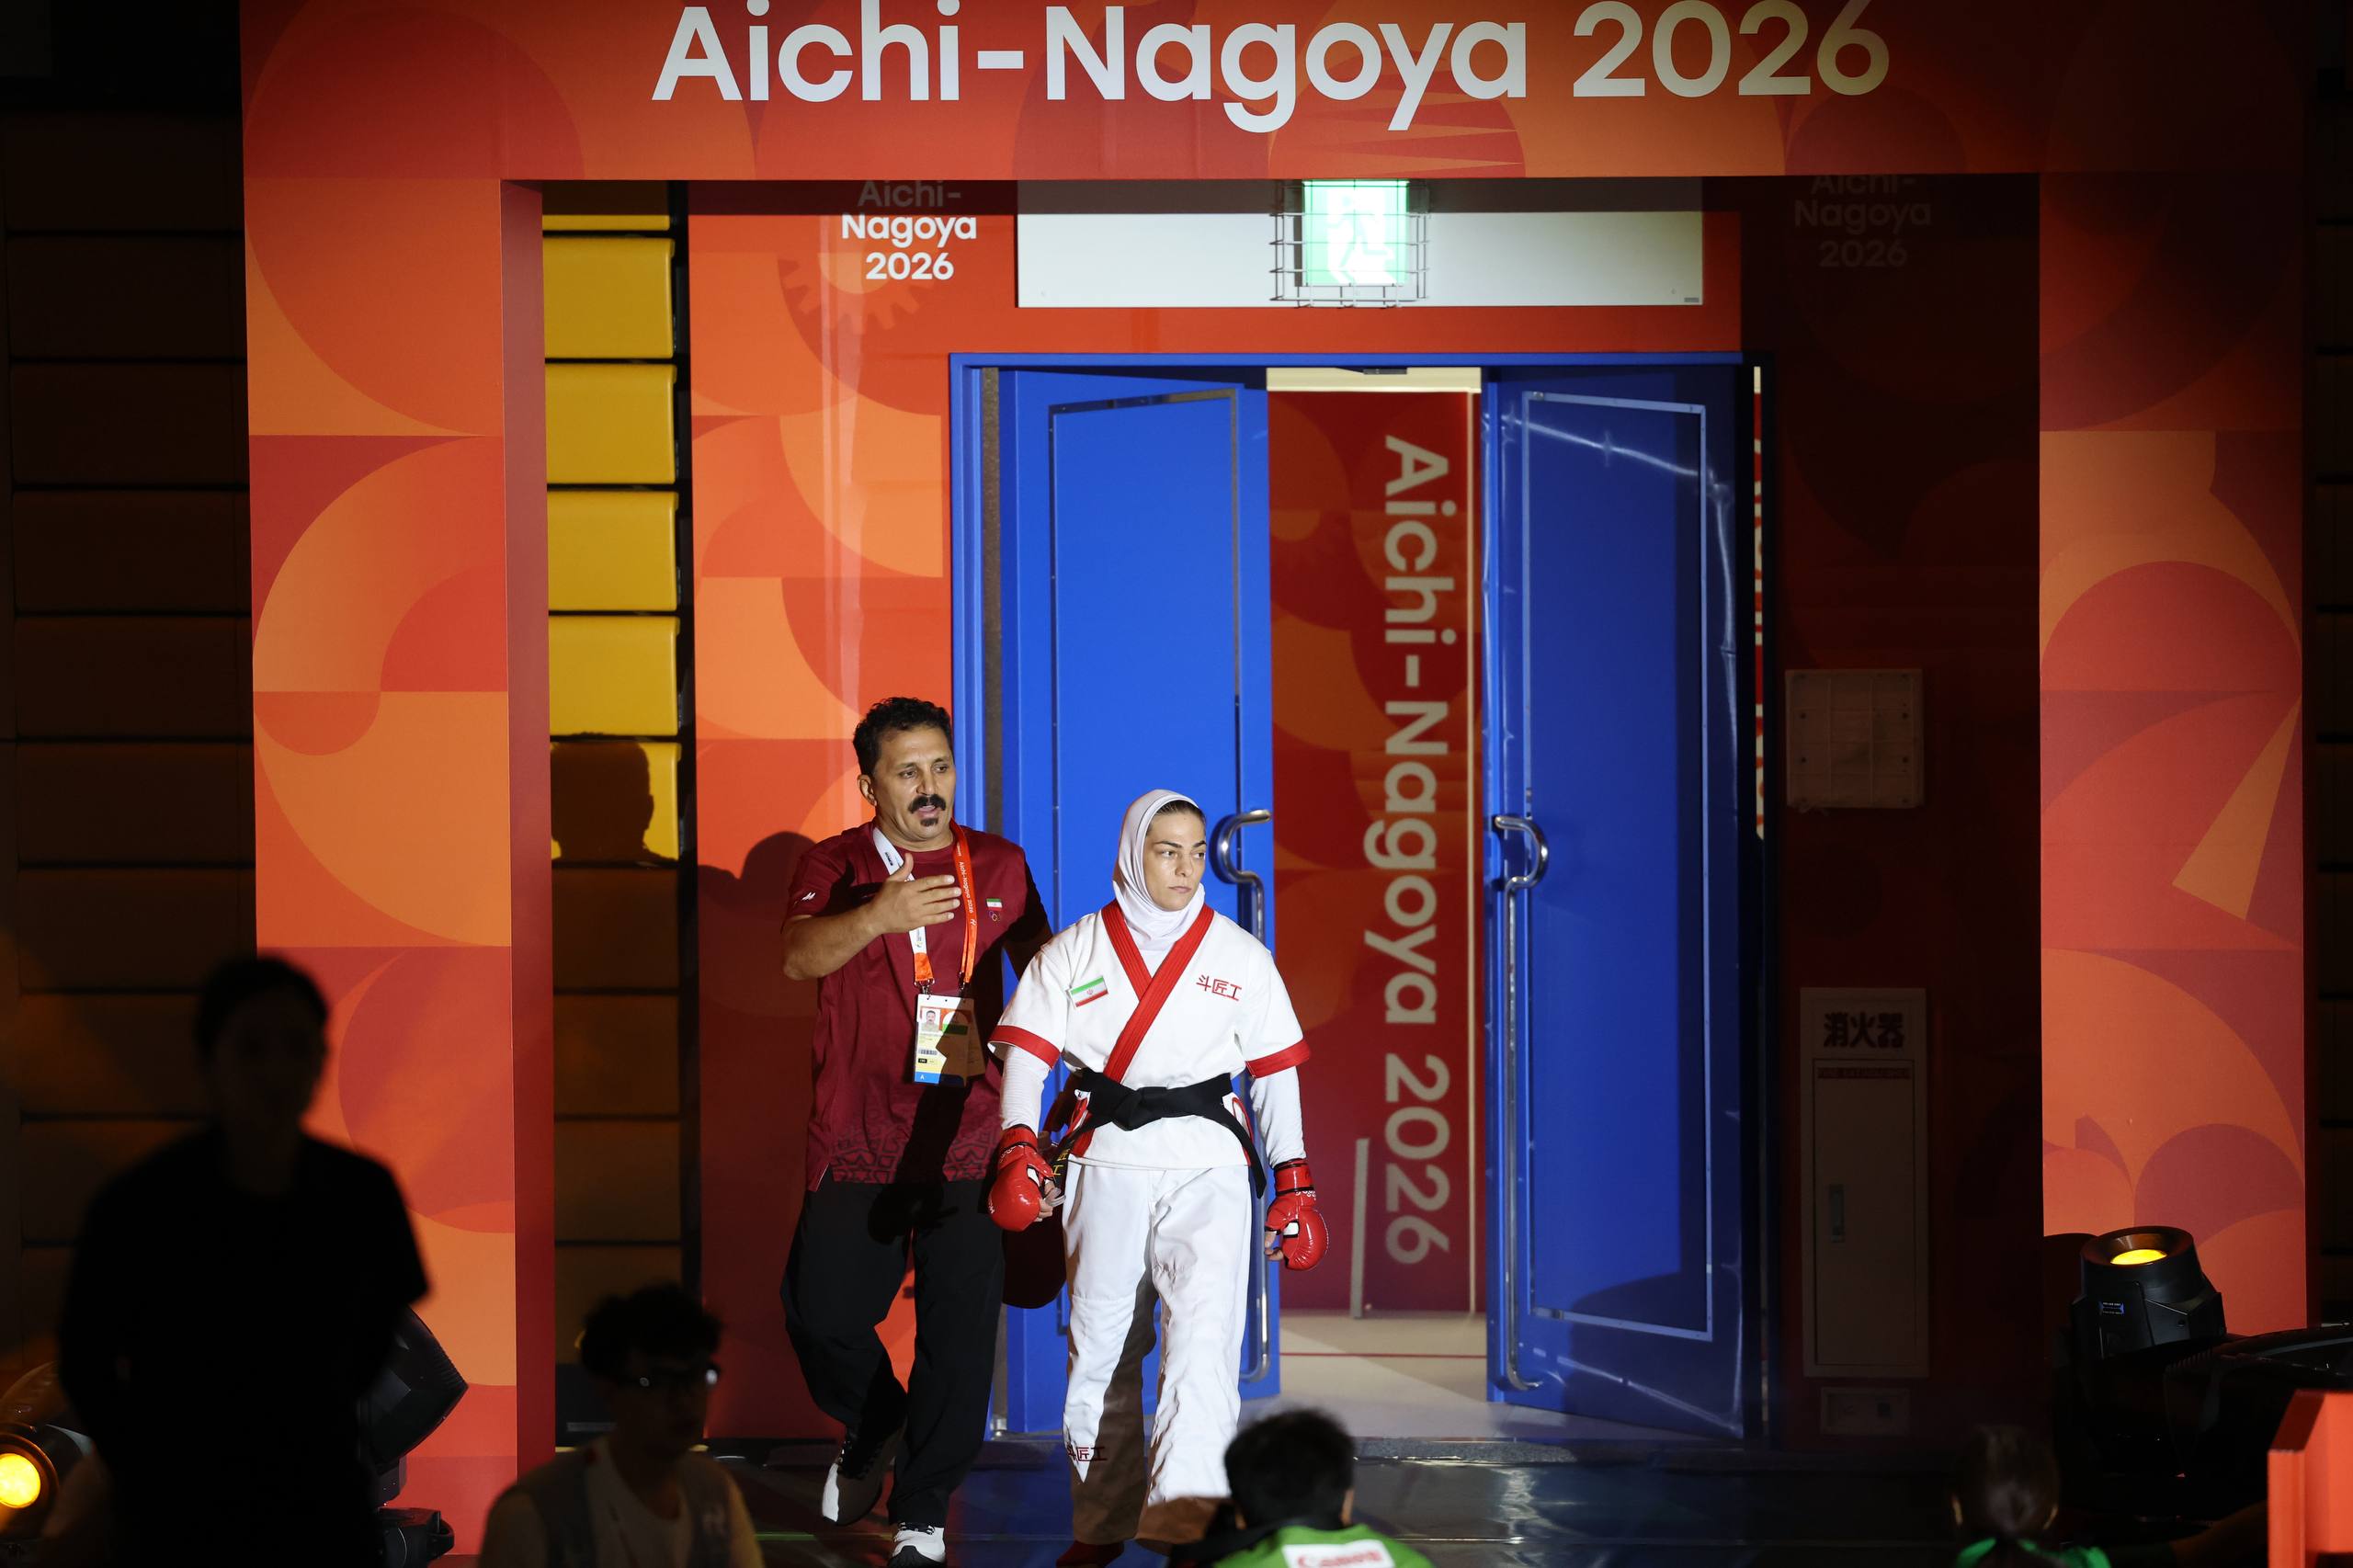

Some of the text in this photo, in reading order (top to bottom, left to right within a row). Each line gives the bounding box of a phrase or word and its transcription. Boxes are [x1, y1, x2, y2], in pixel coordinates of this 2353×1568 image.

[652, 0, 1890, 133] Aichi-Nagoya 2026
[858, 180, 961, 208] Aichi-
[841, 212, 977, 248] Nagoya
[1793, 199, 1933, 235] Nagoya
[866, 252, 954, 280] 2026
[1817, 238, 1908, 268] 2026
[1364, 435, 1457, 1265] Aichi-Nagoya 2026
[1196, 974, 1242, 1001] 斗匠工
[1824, 1012, 1904, 1048] 消火器
